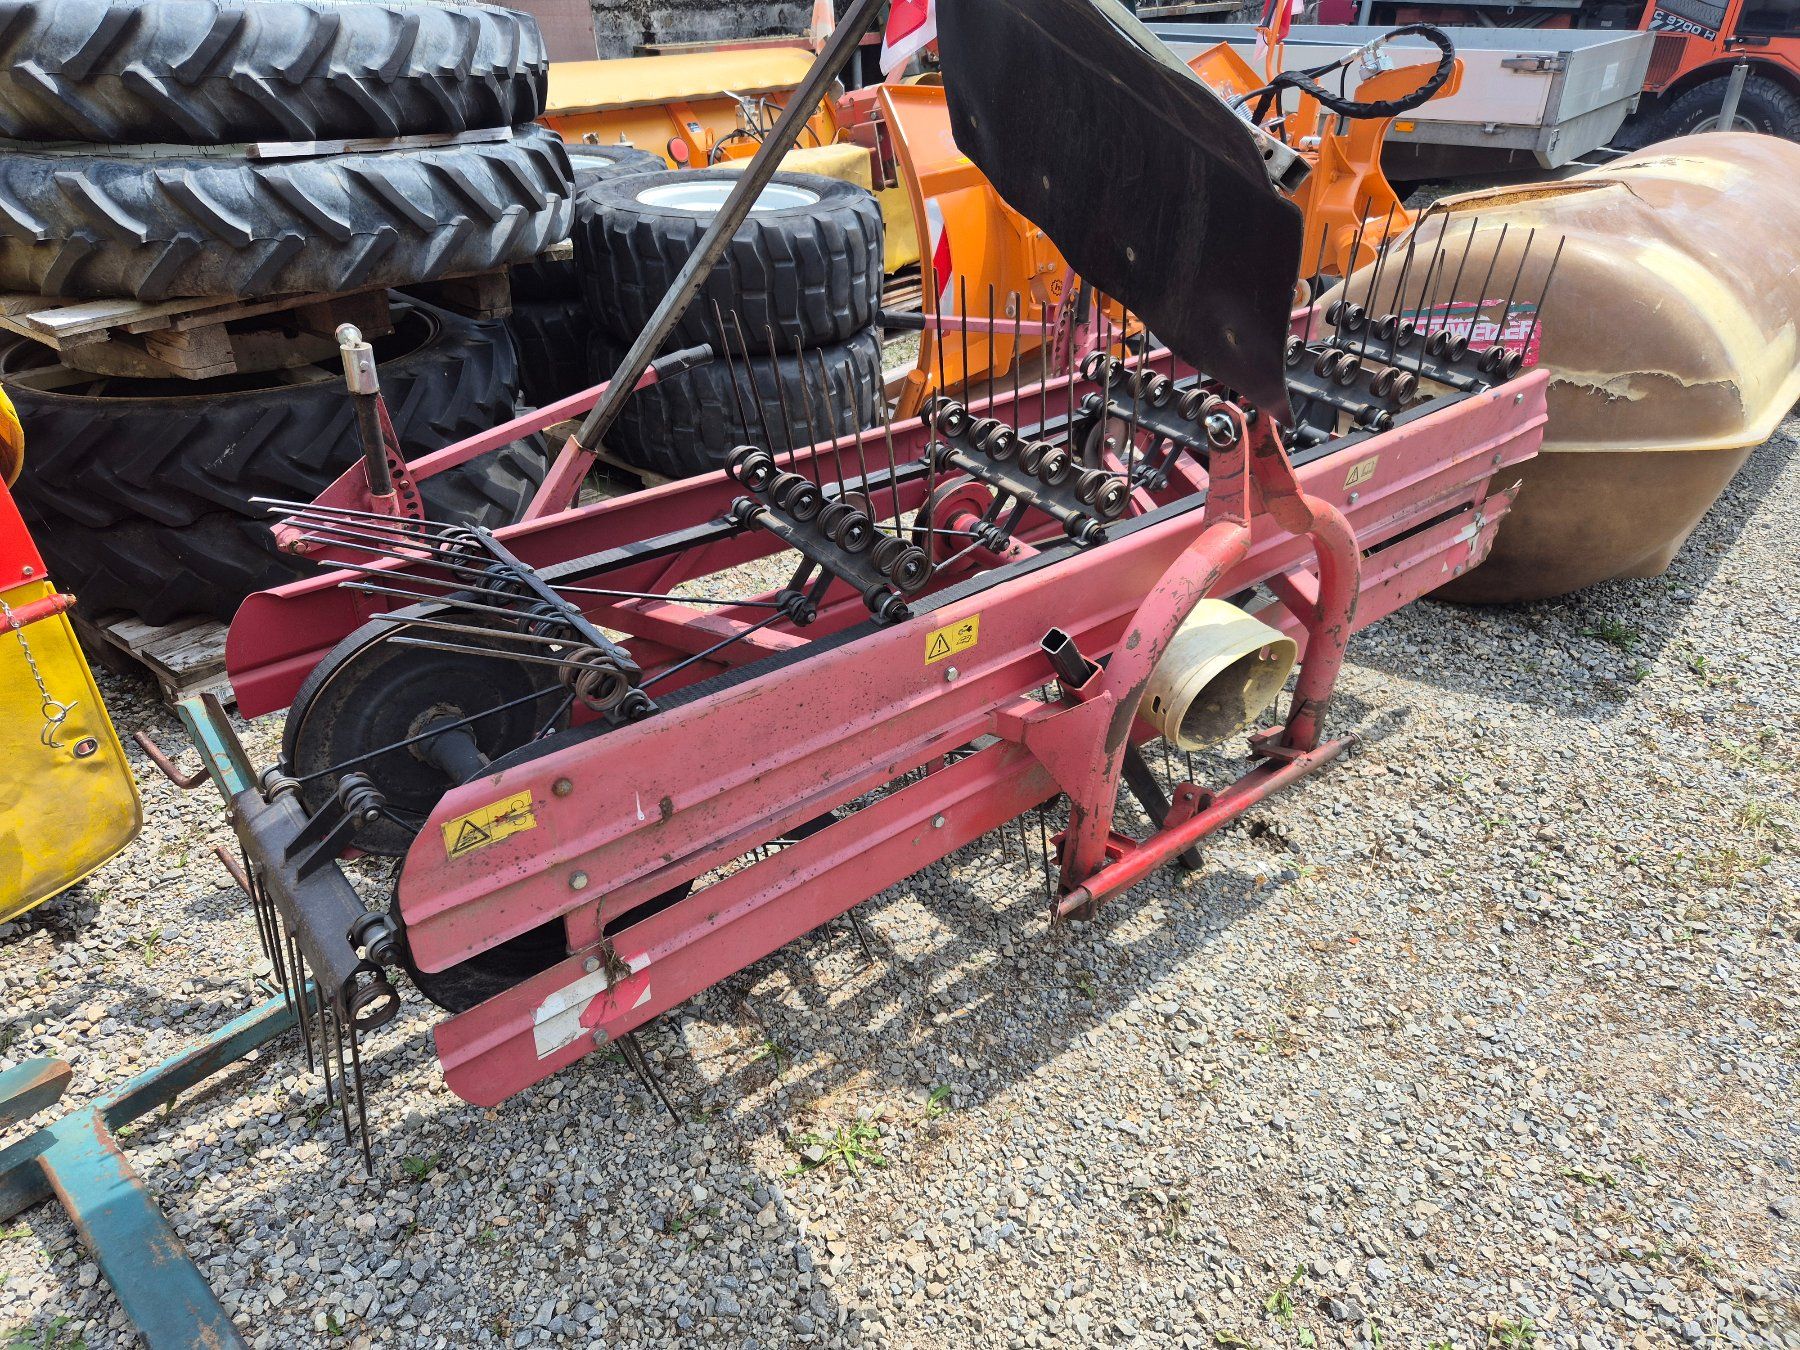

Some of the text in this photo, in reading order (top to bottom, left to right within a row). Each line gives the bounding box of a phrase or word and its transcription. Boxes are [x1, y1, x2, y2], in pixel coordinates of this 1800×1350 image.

[1654, 10, 1715, 40] C 9700 H
